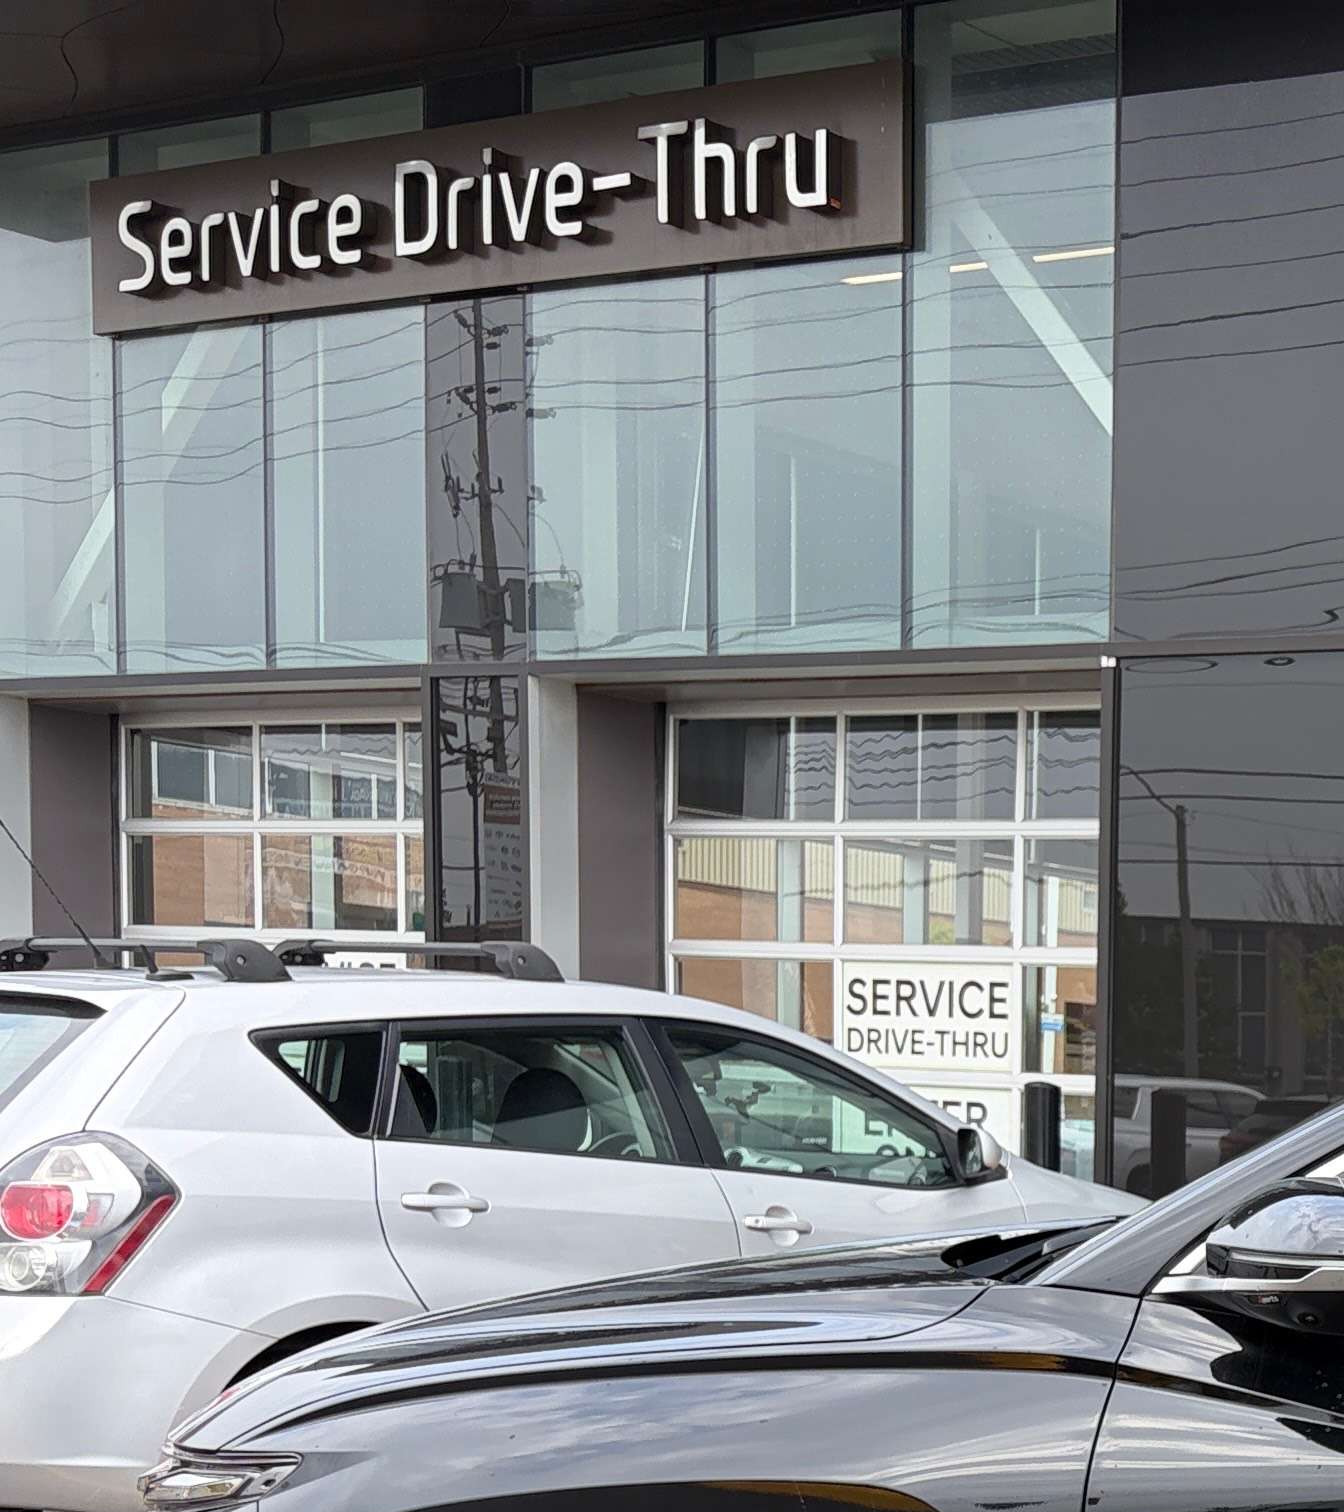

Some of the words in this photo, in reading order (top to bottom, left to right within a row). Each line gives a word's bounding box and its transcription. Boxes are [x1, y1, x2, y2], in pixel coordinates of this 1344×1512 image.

[117, 178, 363, 293] Service
[394, 118, 829, 258] Drive-Thru
[846, 978, 1010, 1020] SERVICE
[847, 1027, 1009, 1059] DRIVE-THRU
